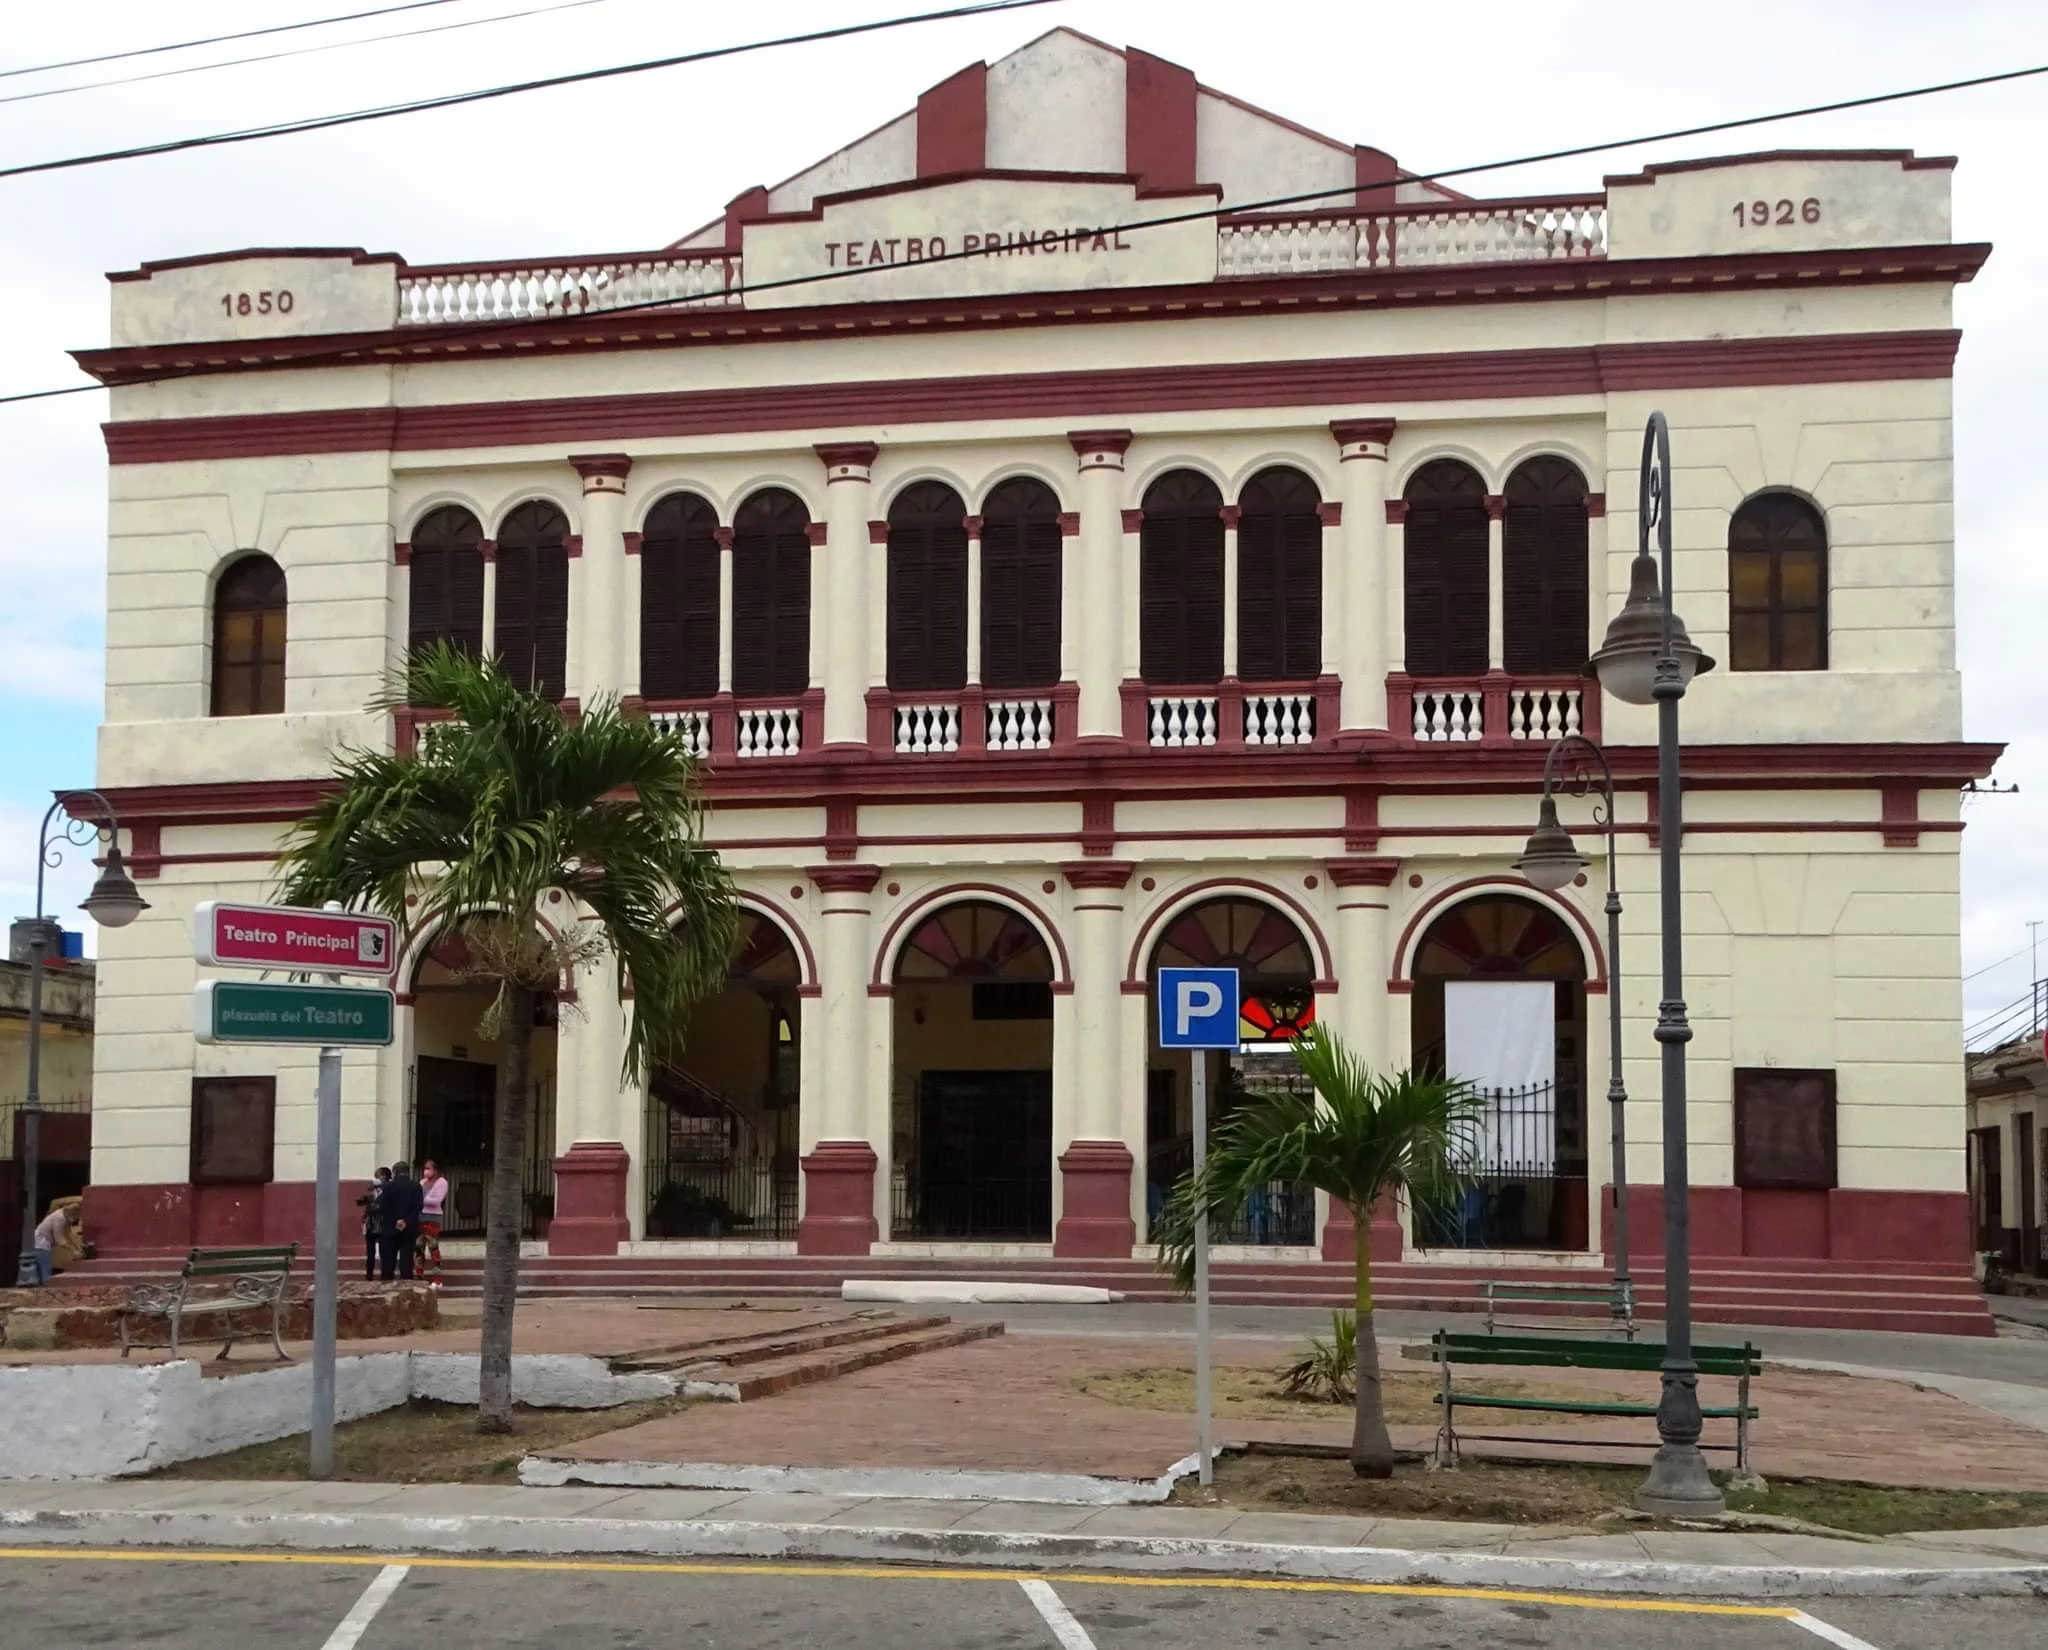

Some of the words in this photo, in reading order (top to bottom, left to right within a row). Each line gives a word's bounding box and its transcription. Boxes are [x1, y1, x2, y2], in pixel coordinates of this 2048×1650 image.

[1732, 197, 1821, 229] 1926
[825, 236, 946, 267] TEATRO
[963, 225, 1131, 259] PRINCIPAL
[221, 290, 294, 318] 1850
[223, 924, 278, 944] Teatro
[285, 930, 355, 951] Principal
[281, 1010, 300, 1023] del
[303, 1006, 363, 1025] Teatro
[1176, 981, 1224, 1036] P
